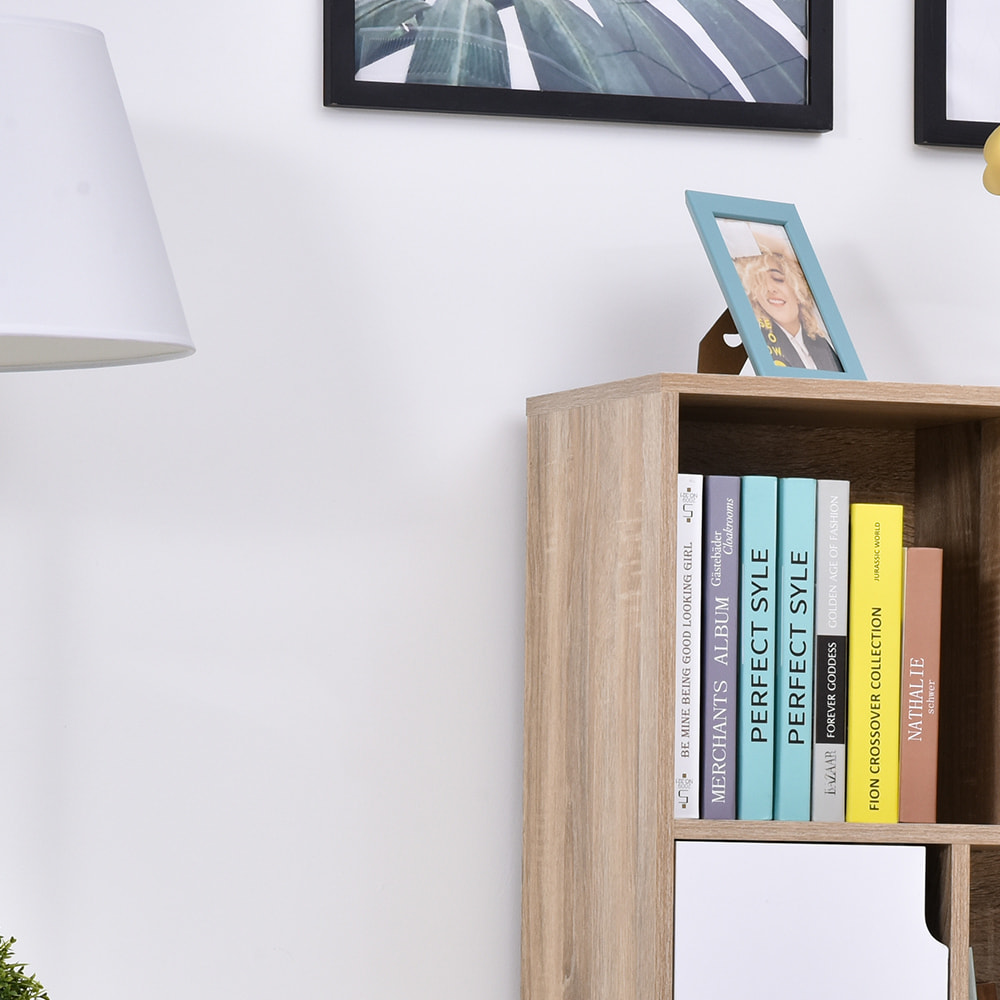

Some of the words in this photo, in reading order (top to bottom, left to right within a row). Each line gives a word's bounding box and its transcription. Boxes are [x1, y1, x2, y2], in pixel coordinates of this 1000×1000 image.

[722, 498, 734, 555] Cloakrooms
[829, 495, 839, 541] FASHION
[683, 542, 693, 571] GIRL
[711, 531, 722, 587] Gästebäder
[828, 560, 838, 583] AGE
[829, 544, 839, 558] OF
[682, 574, 692, 627] LOOKING
[751, 549, 768, 613] SYLE
[790, 551, 808, 615] SYLE
[828, 585, 838, 628] GOLDEN
[682, 630, 692, 664] GOOD
[714, 597, 730, 666] ALBUM
[870, 607, 882, 690] COLLECTION
[681, 668, 691, 704] BEING
[751, 621, 768, 742] PERFECT
[788, 623, 807, 744] PERFECT
[827, 642, 837, 691] GODDESS
[826, 694, 836, 738] FOREVER
[907, 657, 925, 742] NATHALIE
[926, 679, 936, 714] schwer
[681, 709, 690, 737] MINE
[711, 680, 728, 803] MERCHANTS
[870, 694, 881, 774] CROSSOVER
[681, 742, 690, 758] BE
[869, 778, 880, 811] FION
